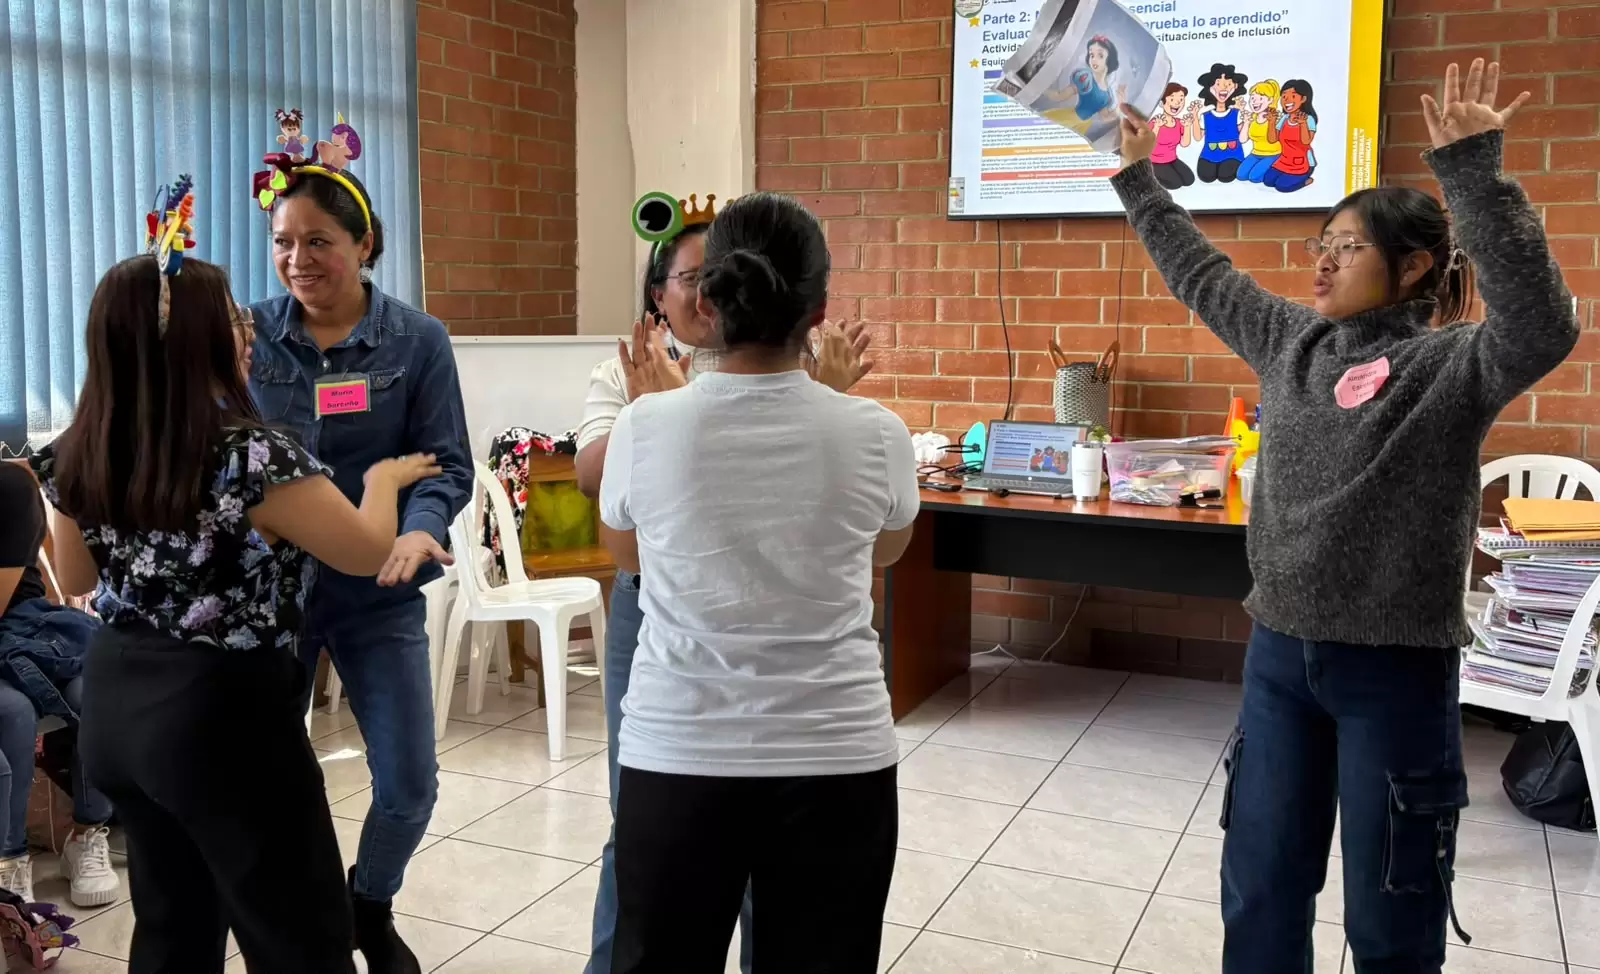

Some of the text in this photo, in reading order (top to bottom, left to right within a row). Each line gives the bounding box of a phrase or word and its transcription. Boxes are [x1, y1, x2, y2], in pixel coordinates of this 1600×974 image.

[983, 13, 1016, 25] Parte
[1019, 11, 1031, 23] 2:
[1129, 0, 1176, 14] sencial
[982, 29, 1031, 42] Evaluac
[1193, 15, 1206, 27] lo
[1221, 29, 1235, 38] de
[1238, 25, 1290, 37] inclusión
[981, 58, 1006, 67] Equip
